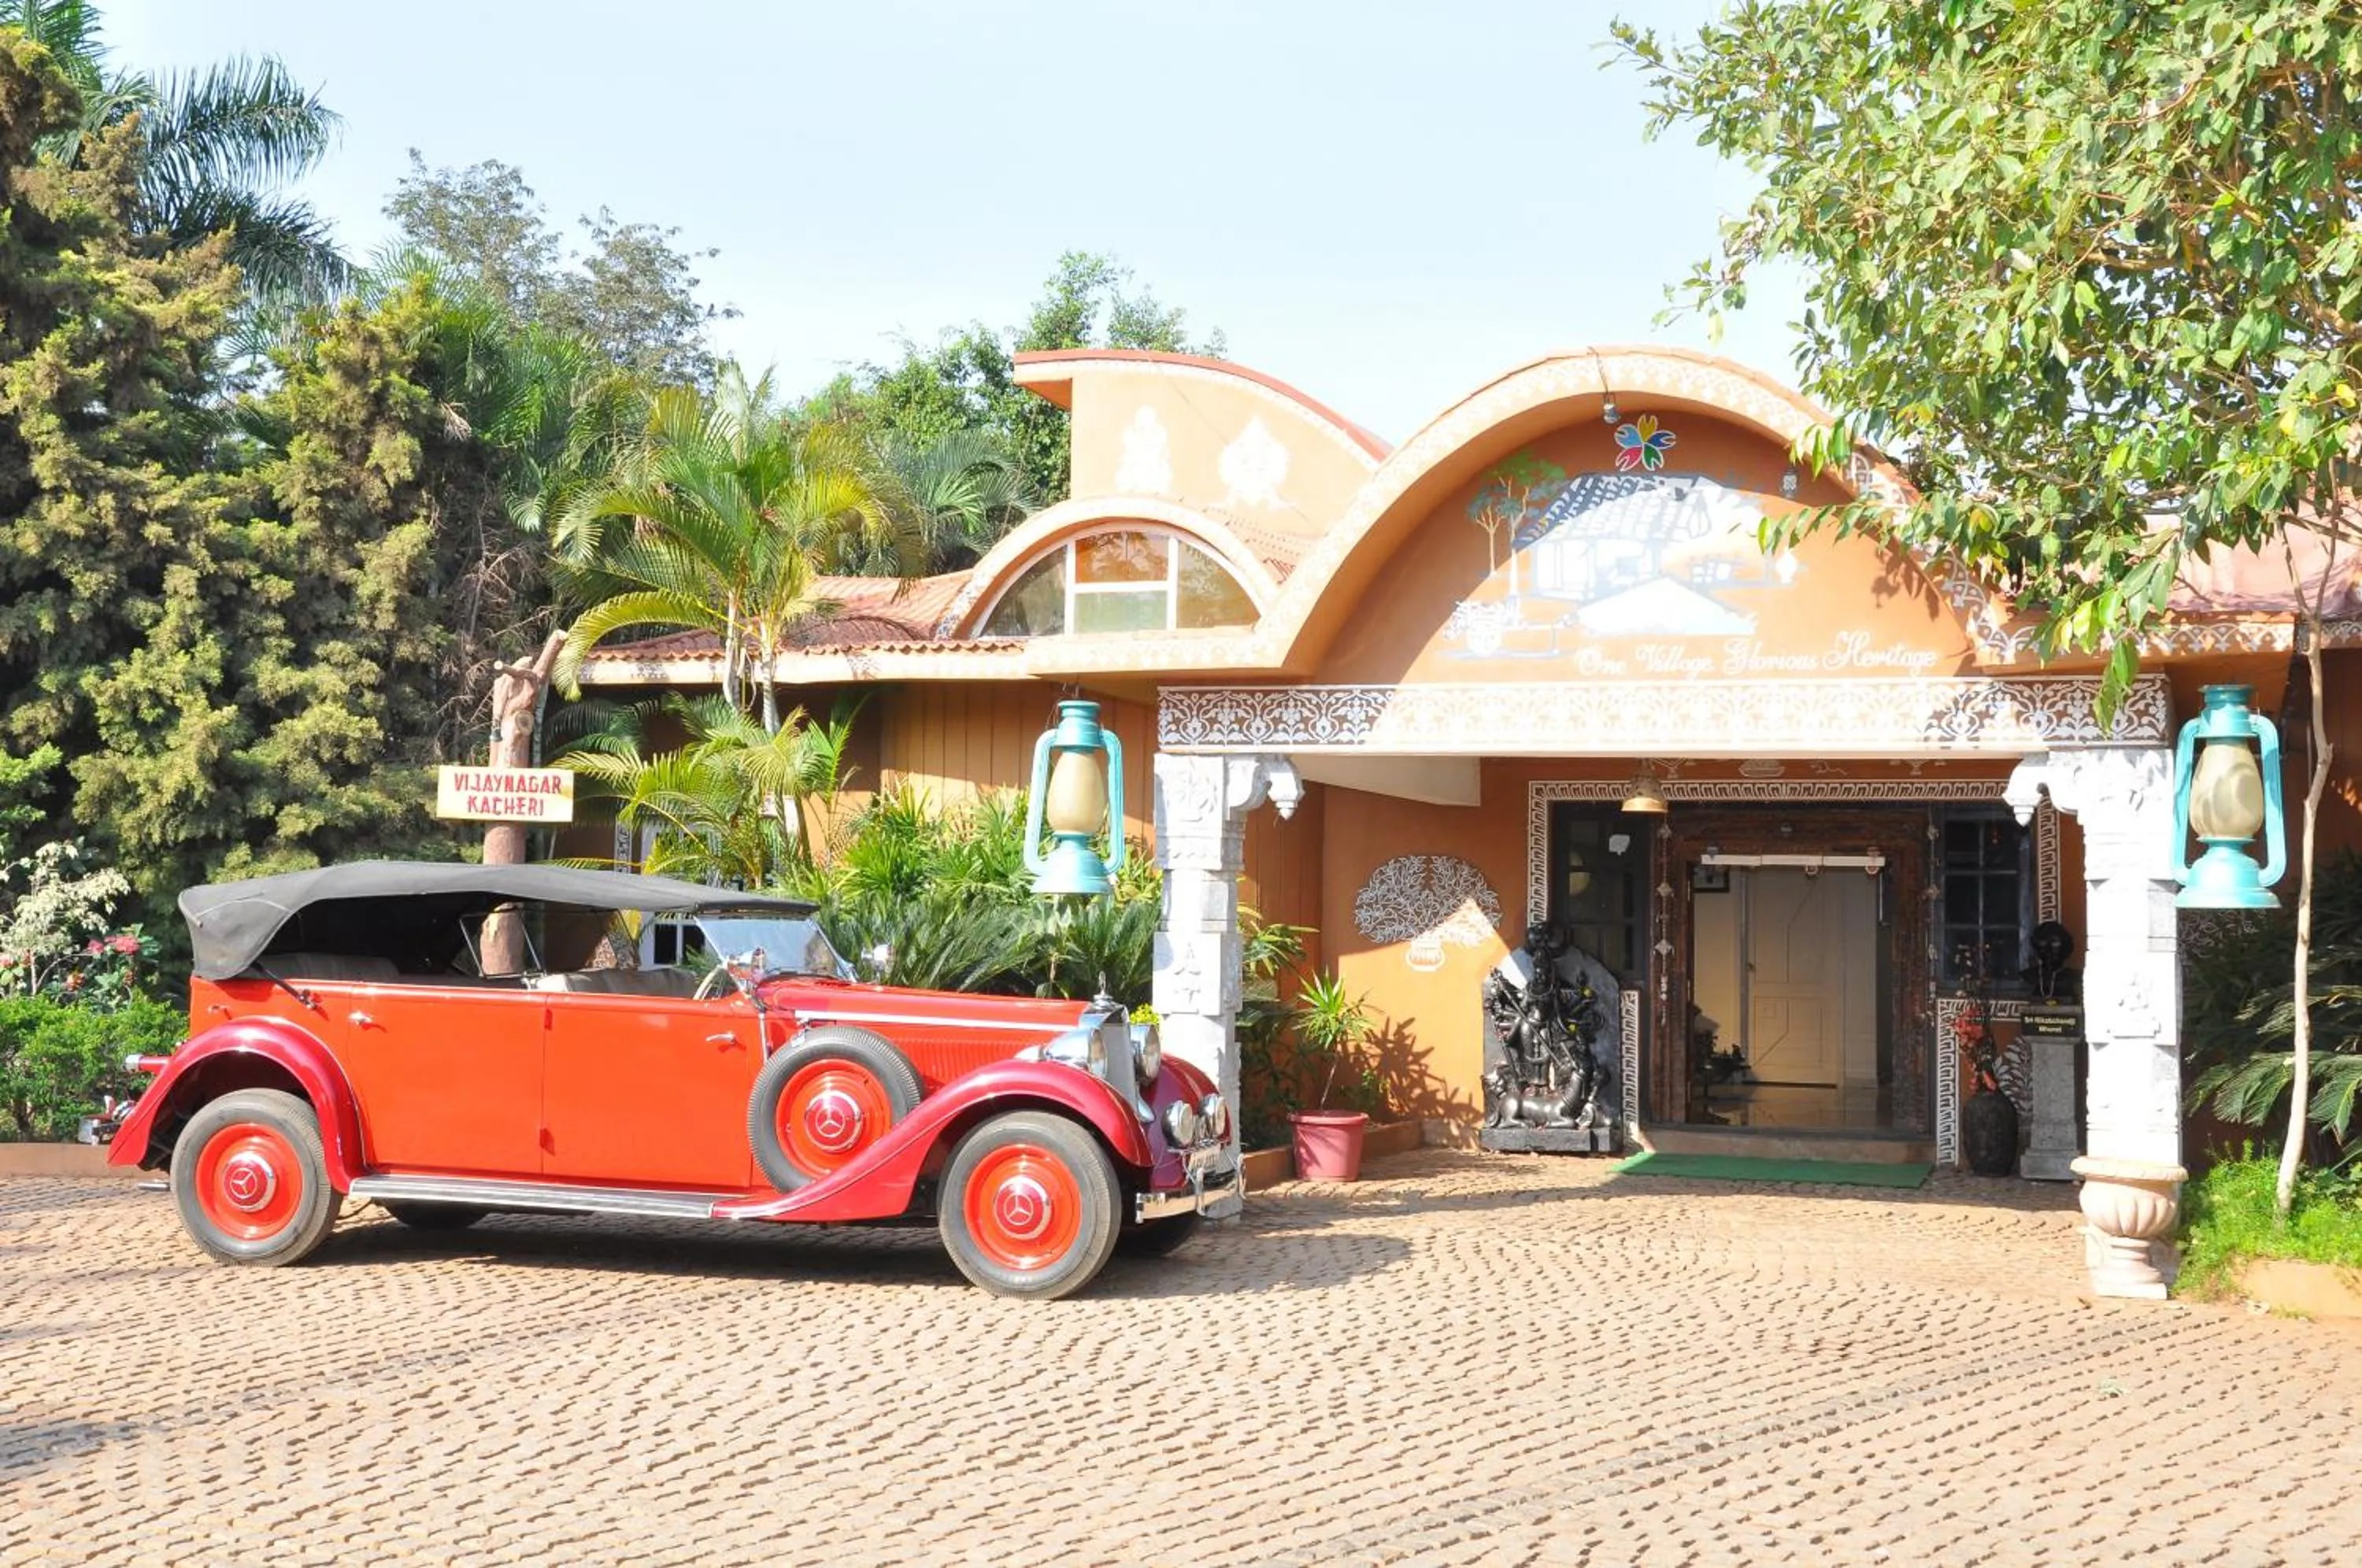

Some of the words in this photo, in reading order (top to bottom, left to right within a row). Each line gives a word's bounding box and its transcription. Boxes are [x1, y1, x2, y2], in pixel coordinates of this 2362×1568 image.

[1578, 645, 1627, 676] One
[1635, 643, 1716, 681] Village
[1723, 638, 1820, 675] Glorious
[1823, 630, 1942, 678] Heritage
[454, 772, 561, 794] VIJAYNAGAR
[467, 795, 544, 816] KACHERI
